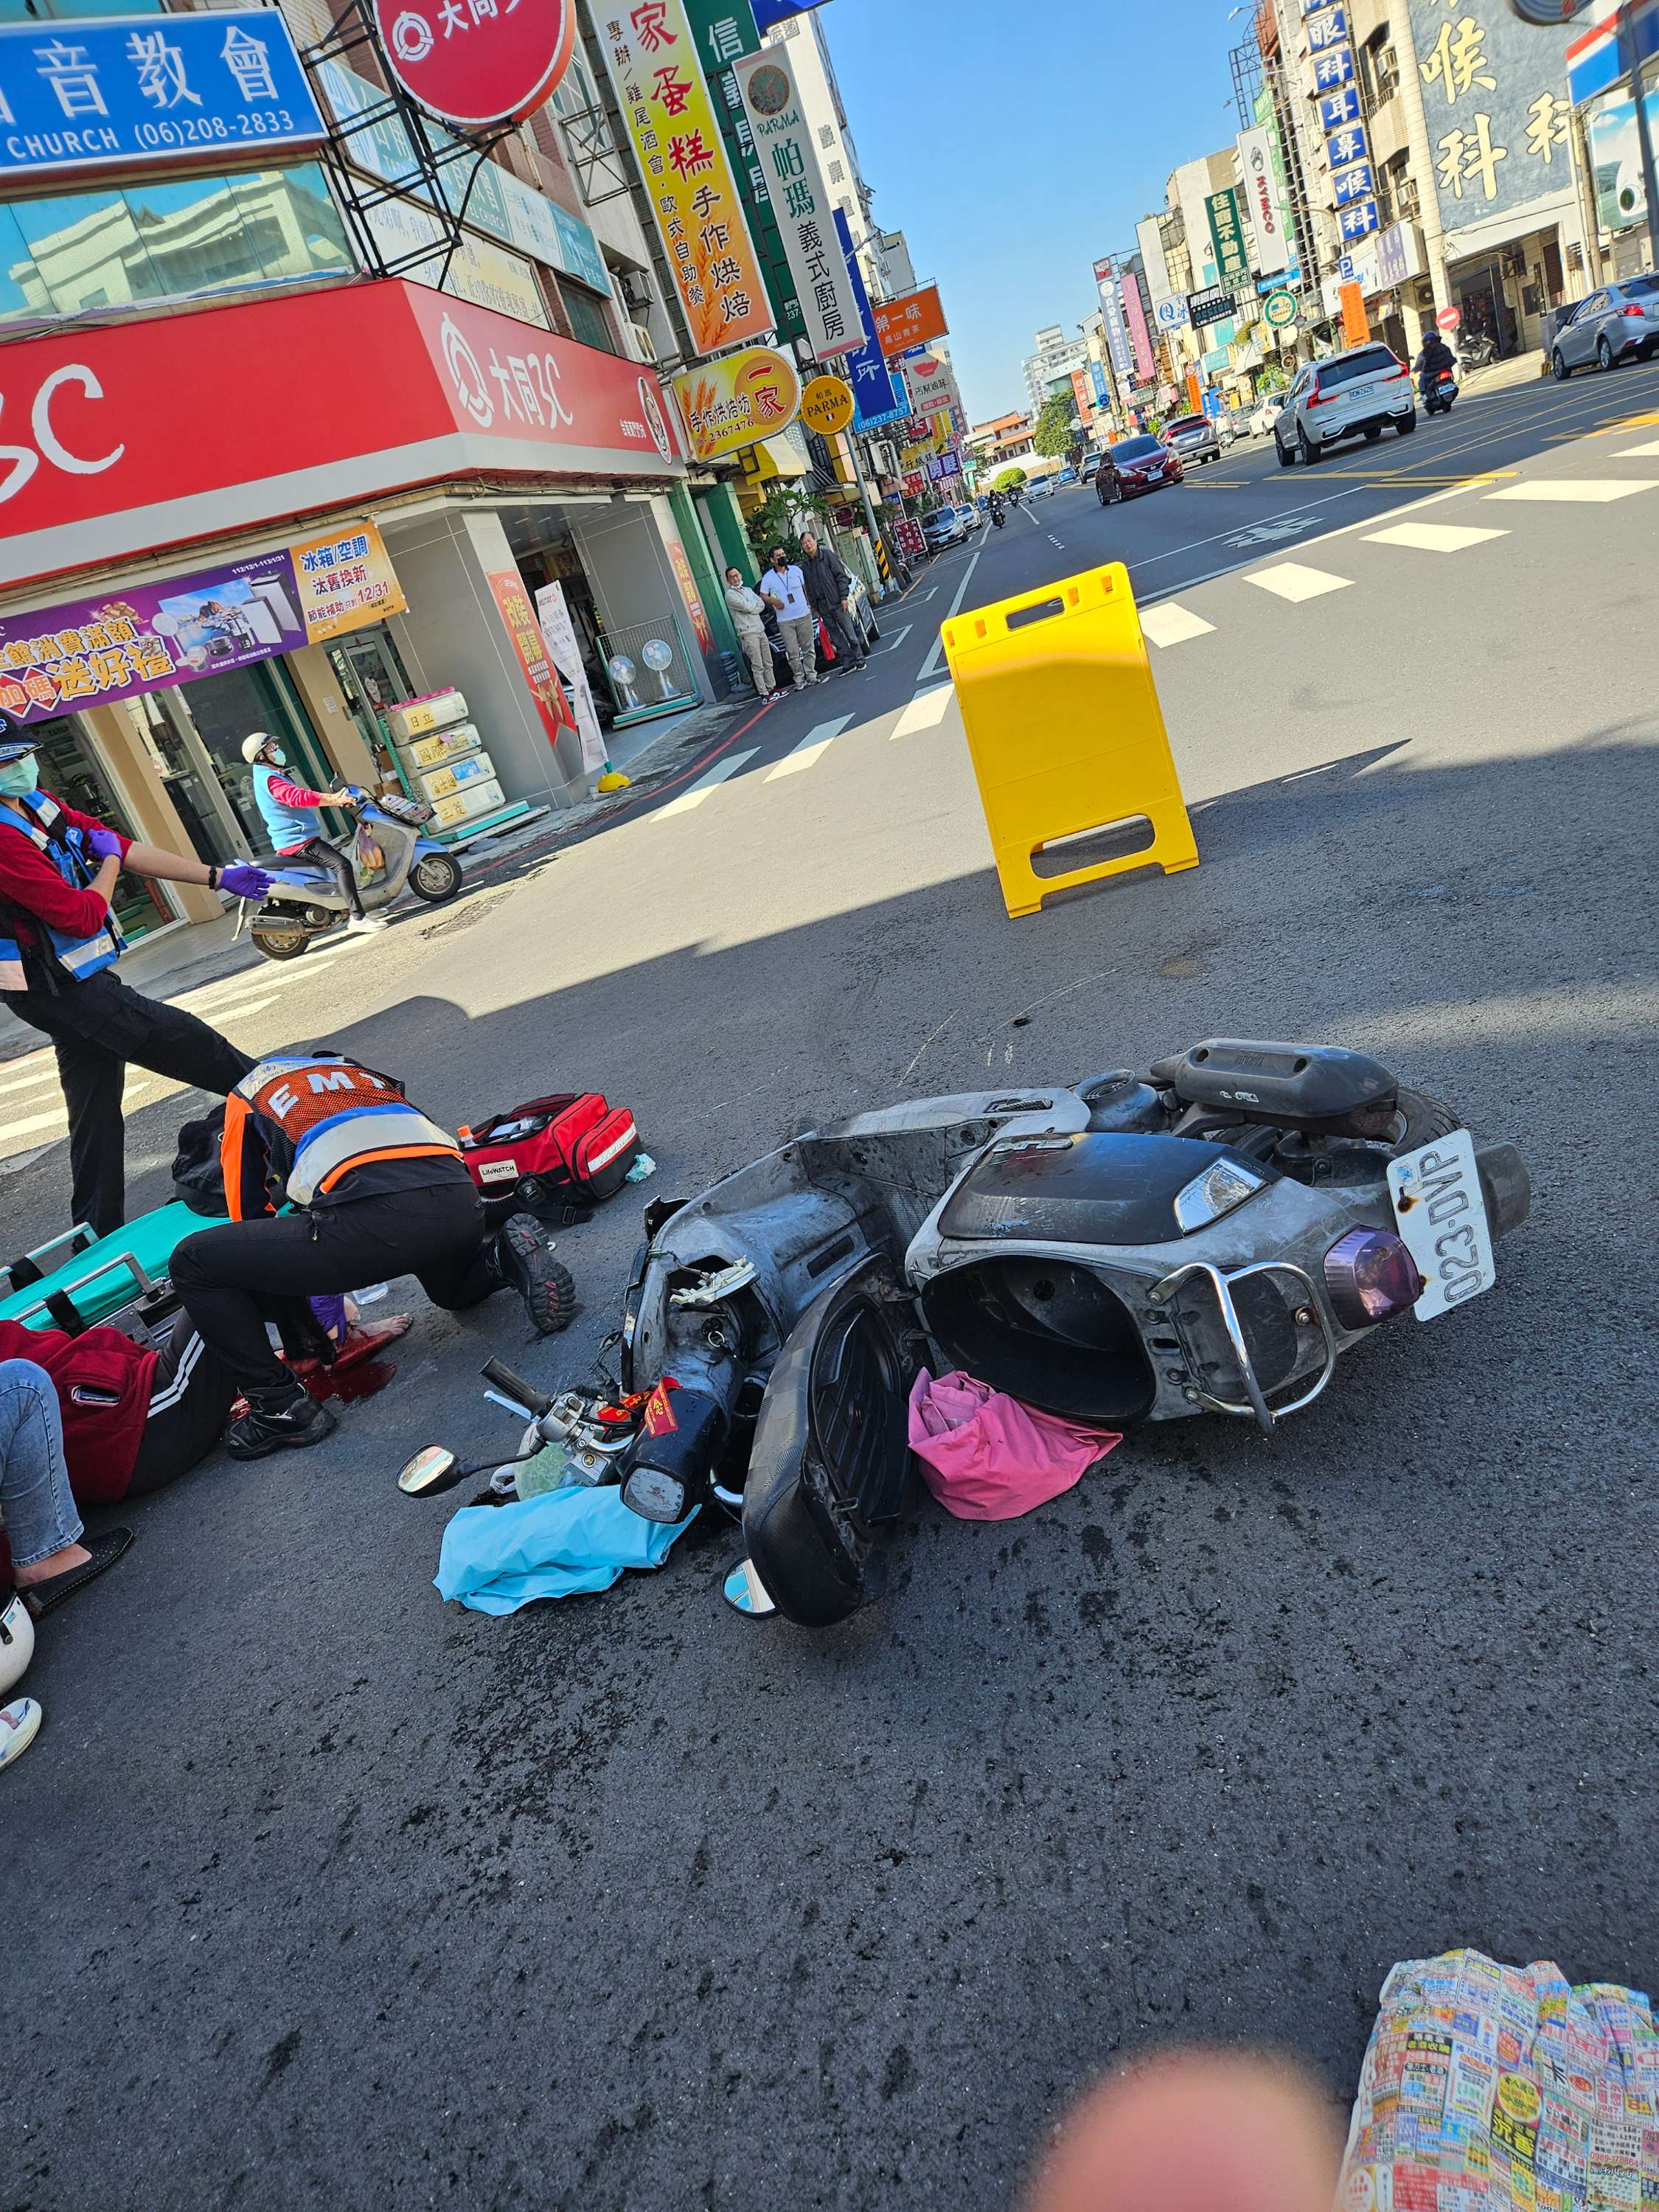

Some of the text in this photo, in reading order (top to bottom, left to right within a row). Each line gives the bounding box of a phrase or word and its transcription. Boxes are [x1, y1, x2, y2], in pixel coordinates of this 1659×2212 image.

[437, 0, 522, 39] 大同
[0, 26, 279, 126] 音教會
[1305, 0, 1377, 234] 眼科耳鼻喉科
[1417, 0, 1509, 201] 喉科
[6, 110, 293, 159] CHURCH (06)208-2833
[772, 138, 815, 219] 帕瑪
[1256, 175, 1276, 234] KYMCO
[691, 185, 751, 322] 手作烘焙
[797, 220, 845, 341] 義式廚房
[875, 303, 922, 333] 第一味
[489, 348, 573, 430] 大同3C
[748, 364, 787, 420] 一家
[806, 394, 849, 419] PARMA
[689, 393, 752, 434] 手作烘焙坊
[928, 453, 959, 479] 剪髮
[300, 535, 369, 574] 冰箱/空調
[312, 564, 368, 596] 汰舊換新
[358, 580, 391, 603] 12/31
[46, 643, 176, 702] 送好禮
[410, 712, 435, 728] 日立
[441, 801, 467, 821] 三菱
[481, 1164, 515, 1176] LifeWATCH
